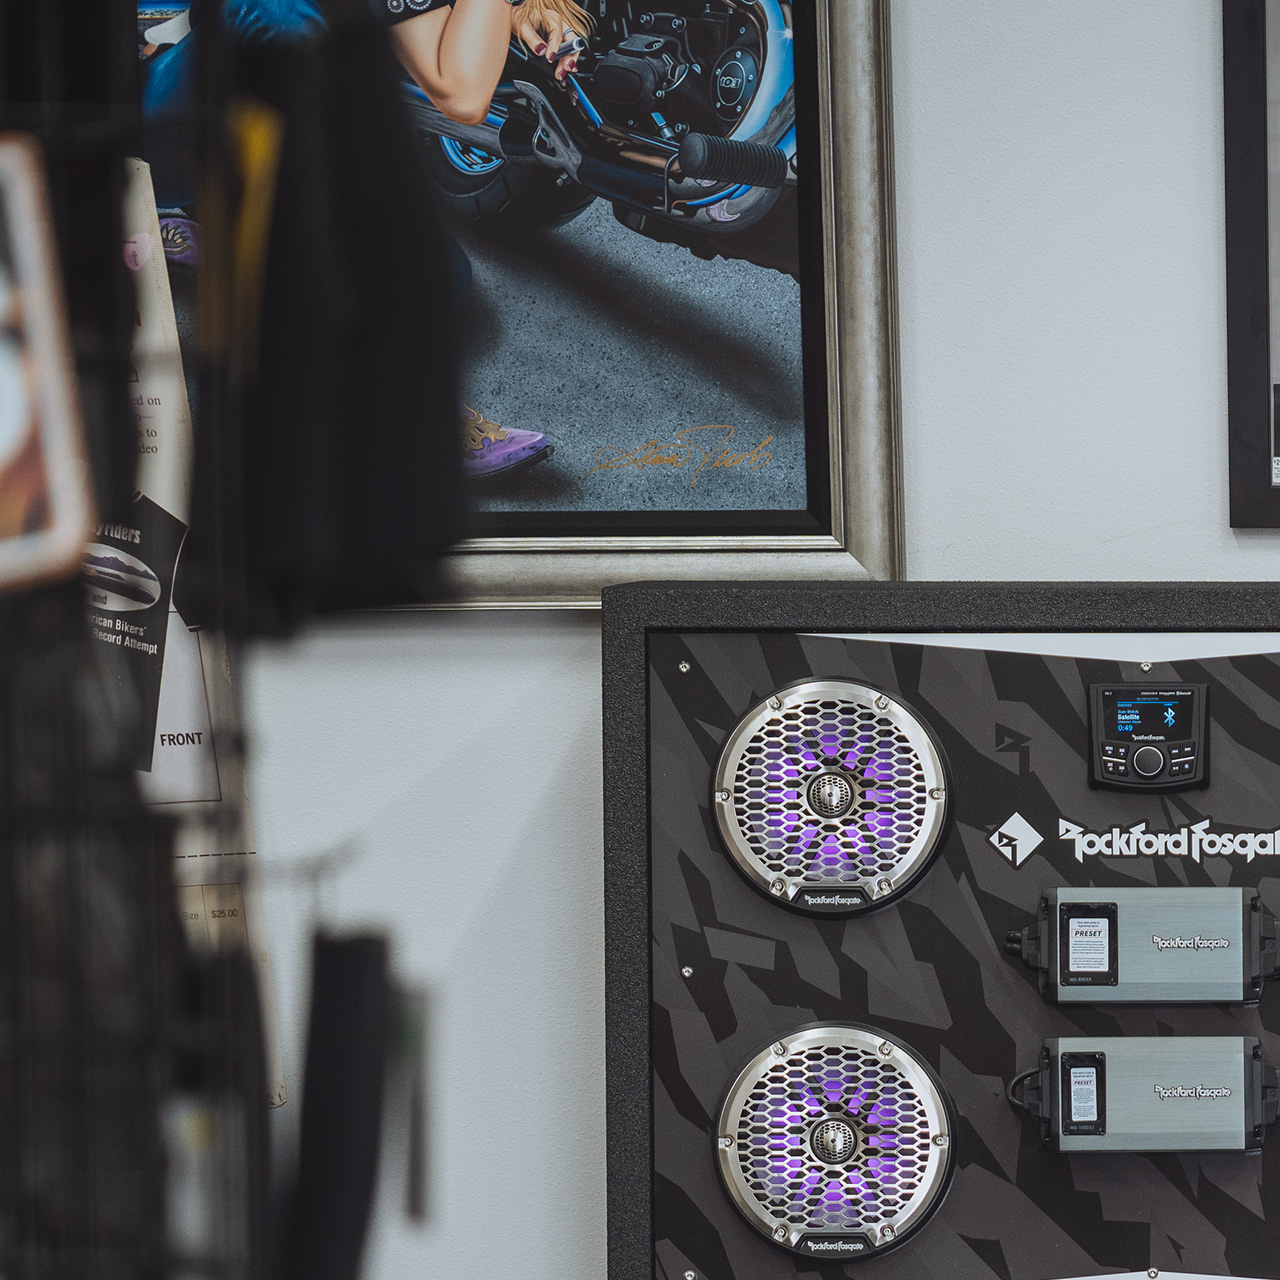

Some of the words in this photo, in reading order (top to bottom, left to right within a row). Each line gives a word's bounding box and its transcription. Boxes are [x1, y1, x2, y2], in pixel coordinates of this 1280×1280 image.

[147, 397, 161, 406] on
[146, 428, 157, 437] to
[124, 634, 158, 655] Attempt
[1117, 724, 1133, 732] 0:49
[160, 732, 203, 747] FRONT
[1058, 818, 1188, 863] Rockford
[211, 908, 238, 918] $25.00
[1152, 935, 1194, 951] Rockford
[1194, 935, 1230, 951] Fosgate
[1154, 1084, 1195, 1100] Rockford
[1195, 1084, 1232, 1100] Fosgate
